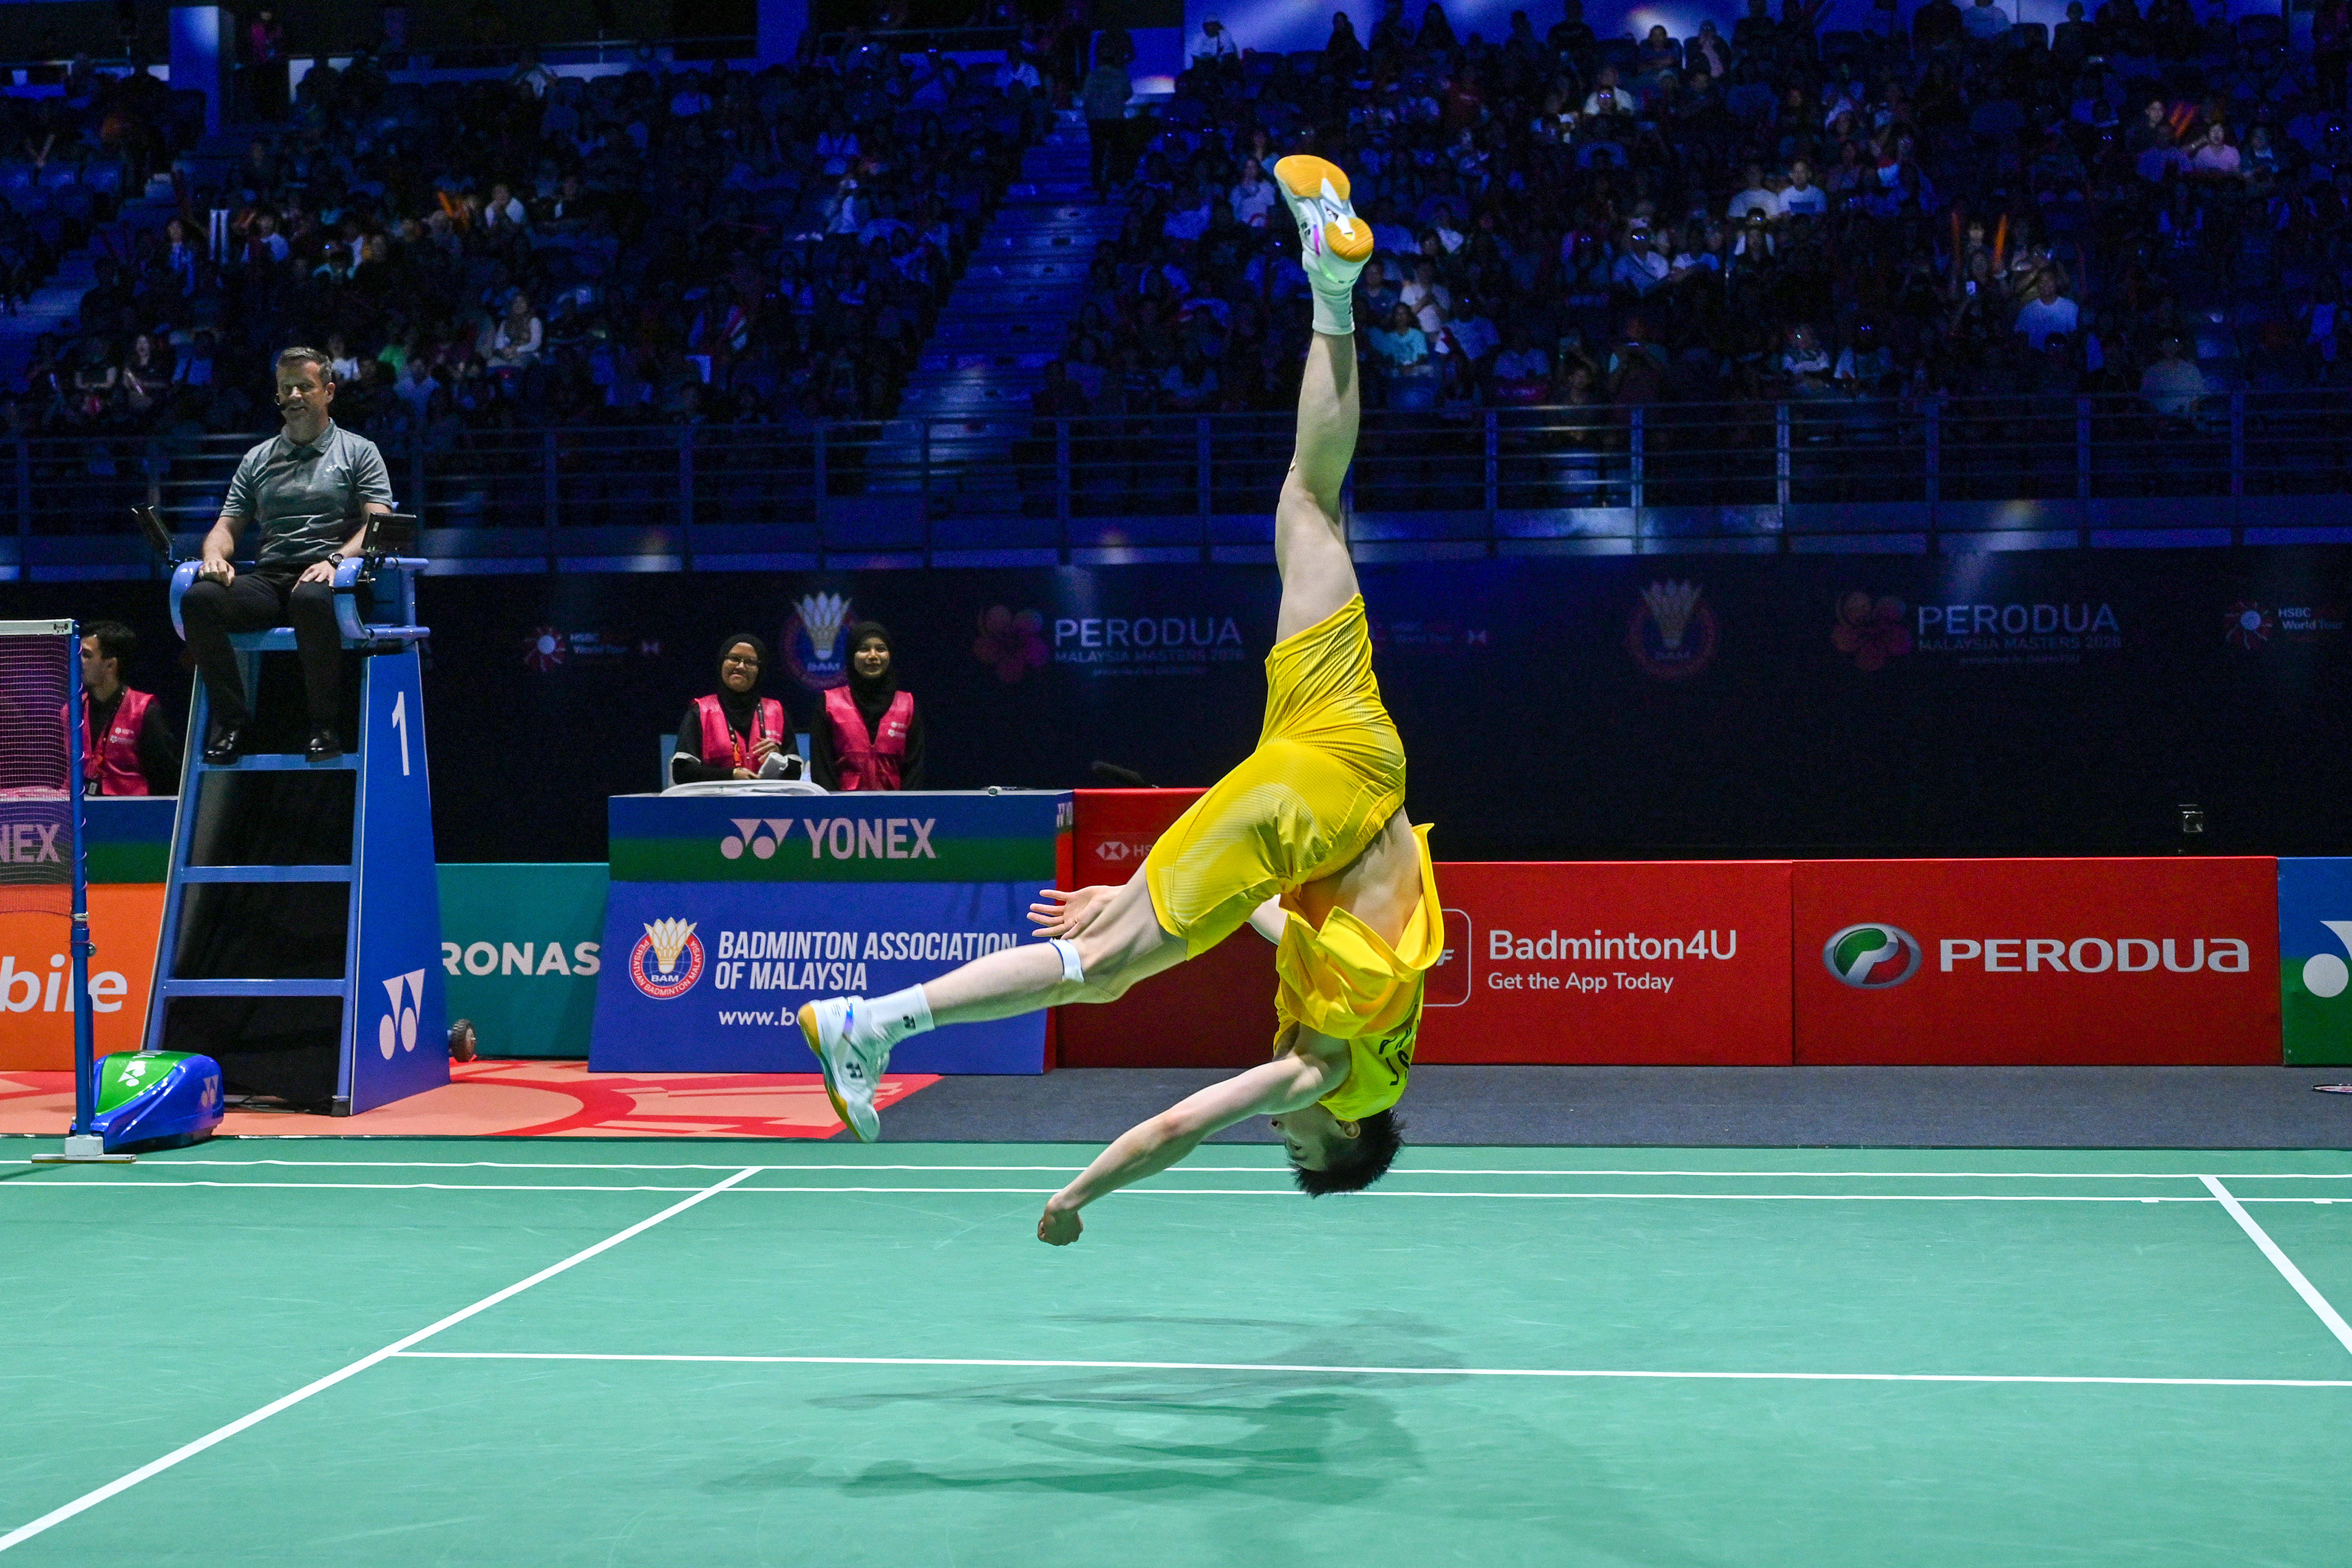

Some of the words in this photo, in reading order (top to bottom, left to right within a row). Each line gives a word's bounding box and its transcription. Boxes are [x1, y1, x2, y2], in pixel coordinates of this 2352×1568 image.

[1918, 604, 2120, 635] PERODUA
[2278, 607, 2311, 617] HSBC
[2282, 620, 2316, 630] World
[1054, 617, 1243, 647] PERODUA
[1919, 637, 1999, 650] MALAYSIA
[2004, 636, 2081, 649] MASTERS
[1054, 651, 1130, 663] MALAYSIA
[392, 691, 410, 776] 1
[803, 818, 936, 859] YONEX
[718, 931, 861, 959] BADMINTON
[863, 932, 1017, 961] ASSOCIATION
[1489, 929, 1737, 960] Badminton4U
[633, 939, 650, 986] PERSATUAN
[643, 980, 691, 996] BADMINTON
[688, 940, 701, 980] MALAYSIA
[715, 962, 744, 989] OF
[750, 962, 867, 990] MALAYSIA
[1488, 972, 1522, 989] Get
[1527, 972, 1560, 989] the
[1566, 972, 1607, 993] App
[1613, 972, 1674, 993] Today
